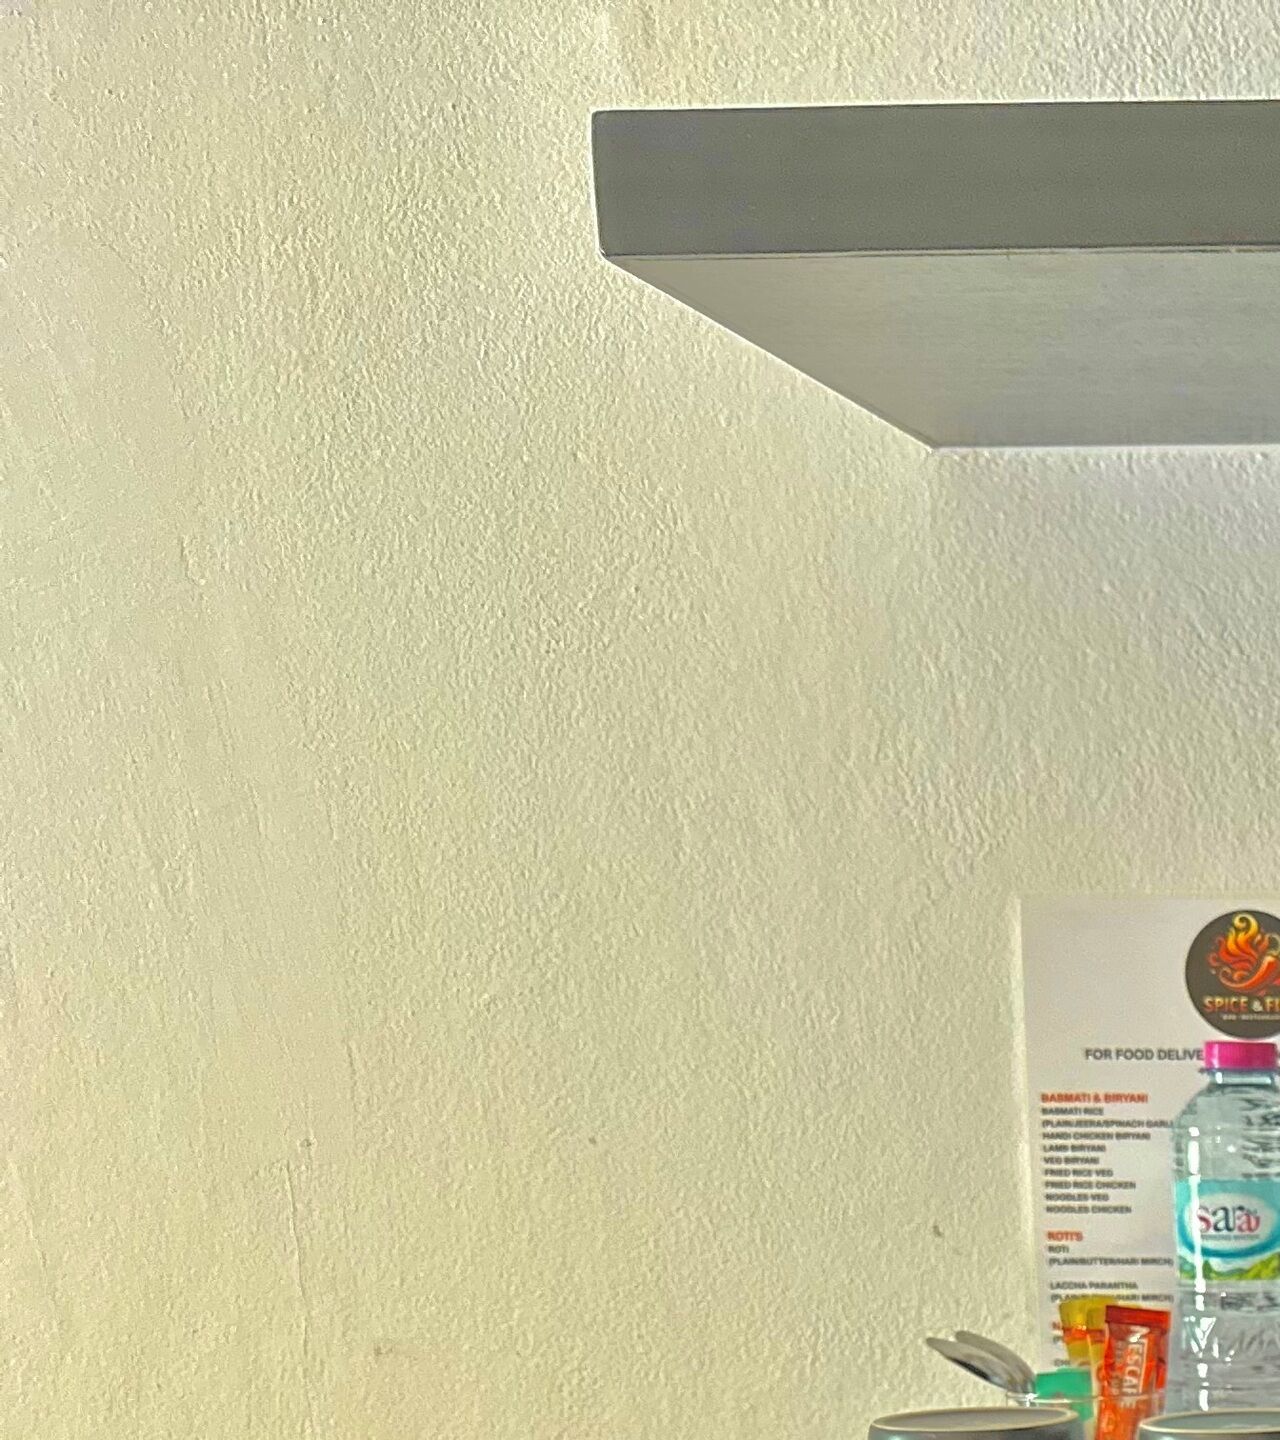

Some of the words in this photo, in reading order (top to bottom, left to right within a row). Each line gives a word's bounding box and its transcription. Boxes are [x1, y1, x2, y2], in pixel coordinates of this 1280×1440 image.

[1204, 996, 1249, 1012] SPICE
[1252, 1000, 1264, 1012] &
[1085, 1048, 1113, 1061] FOR
[1116, 1048, 1155, 1061] FOOD
[1158, 1048, 1205, 1061] DELIVE
[1104, 1093, 1148, 1103] BIRYANI
